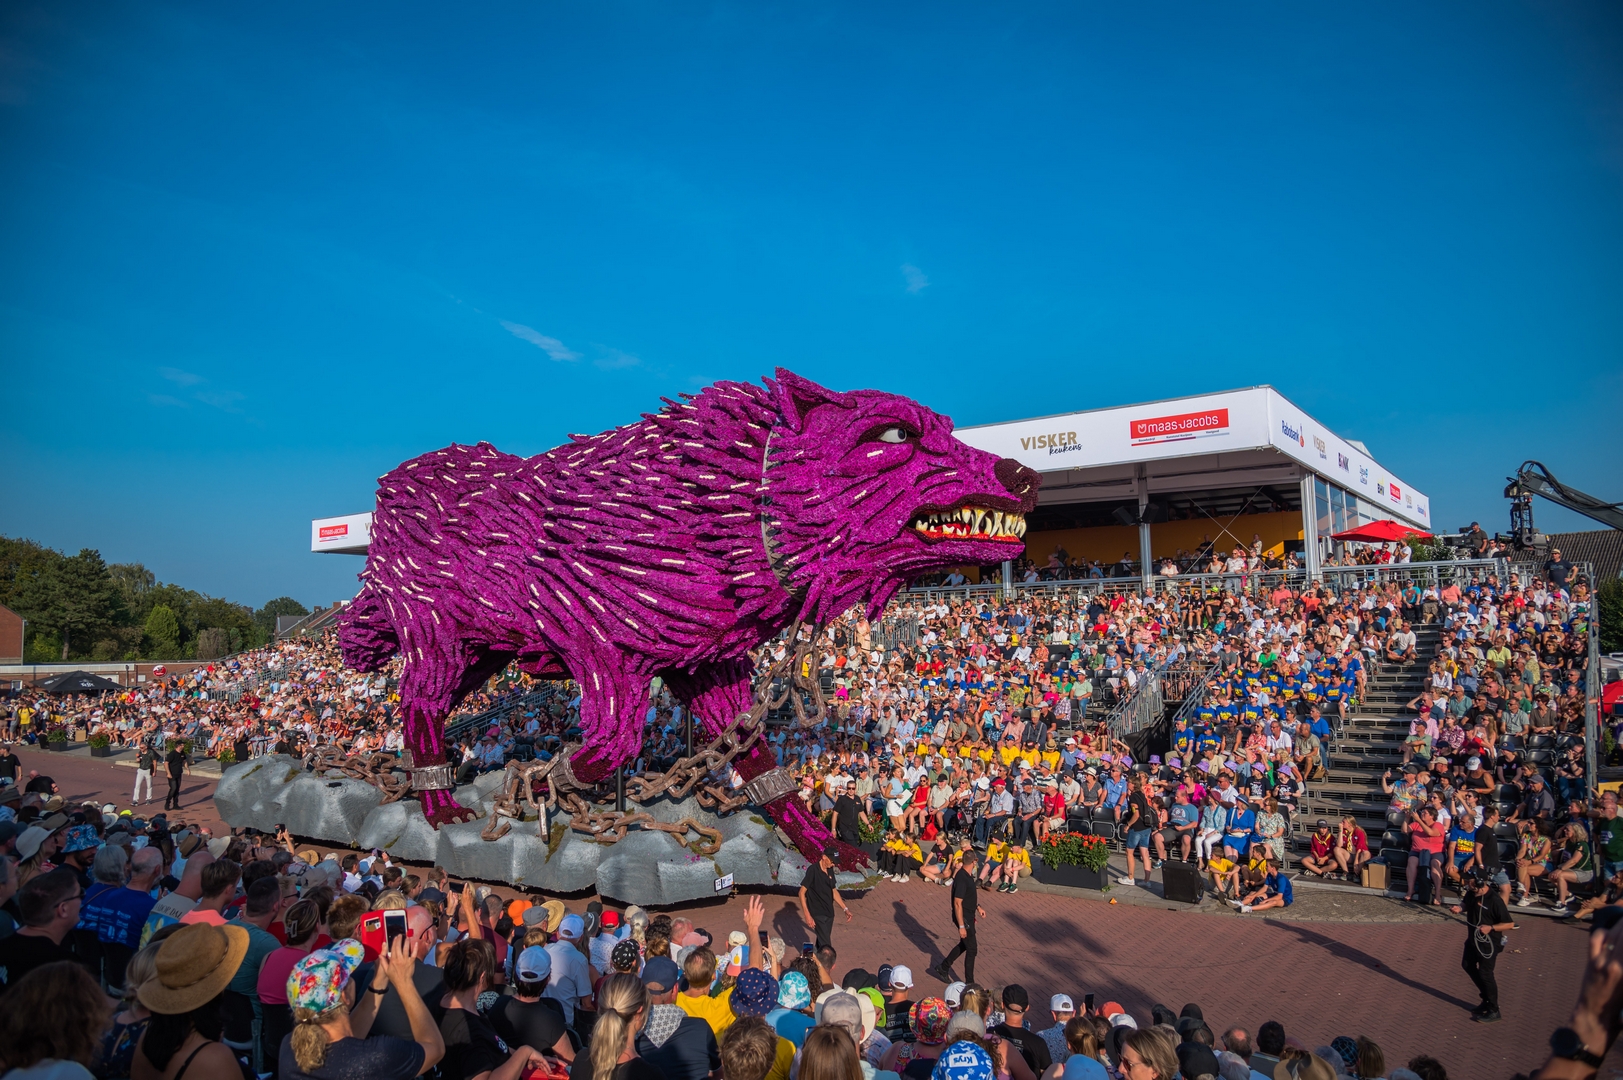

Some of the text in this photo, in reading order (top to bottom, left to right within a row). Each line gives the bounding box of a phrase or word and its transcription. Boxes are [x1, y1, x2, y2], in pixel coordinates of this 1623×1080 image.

[1020, 431, 1077, 451] VISKER
[1049, 442, 1082, 456] keukens
[953, 1055, 973, 1065] Krys
